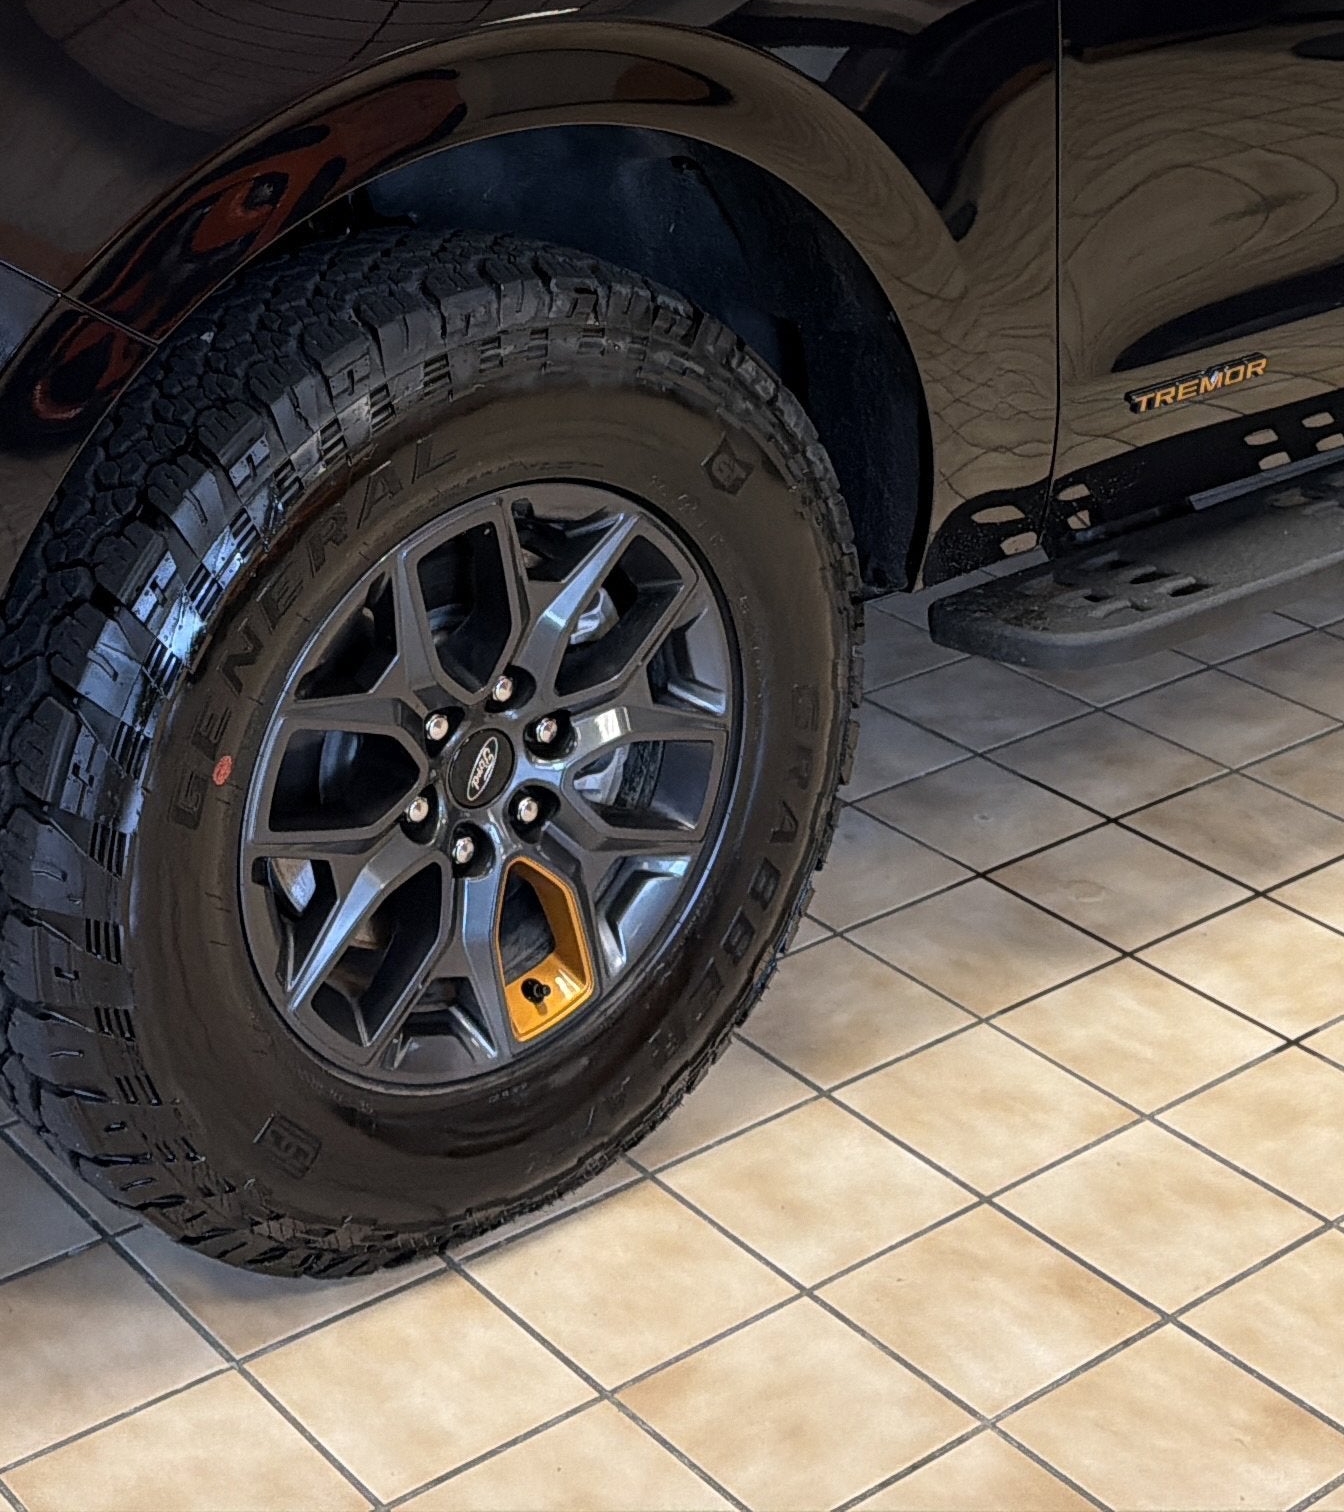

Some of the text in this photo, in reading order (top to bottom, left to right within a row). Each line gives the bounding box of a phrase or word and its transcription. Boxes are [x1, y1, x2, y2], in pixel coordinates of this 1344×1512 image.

[1128, 354, 1269, 414] TREMOR
[169, 433, 458, 833] GENERAL
[470, 744, 498, 793] Ford
